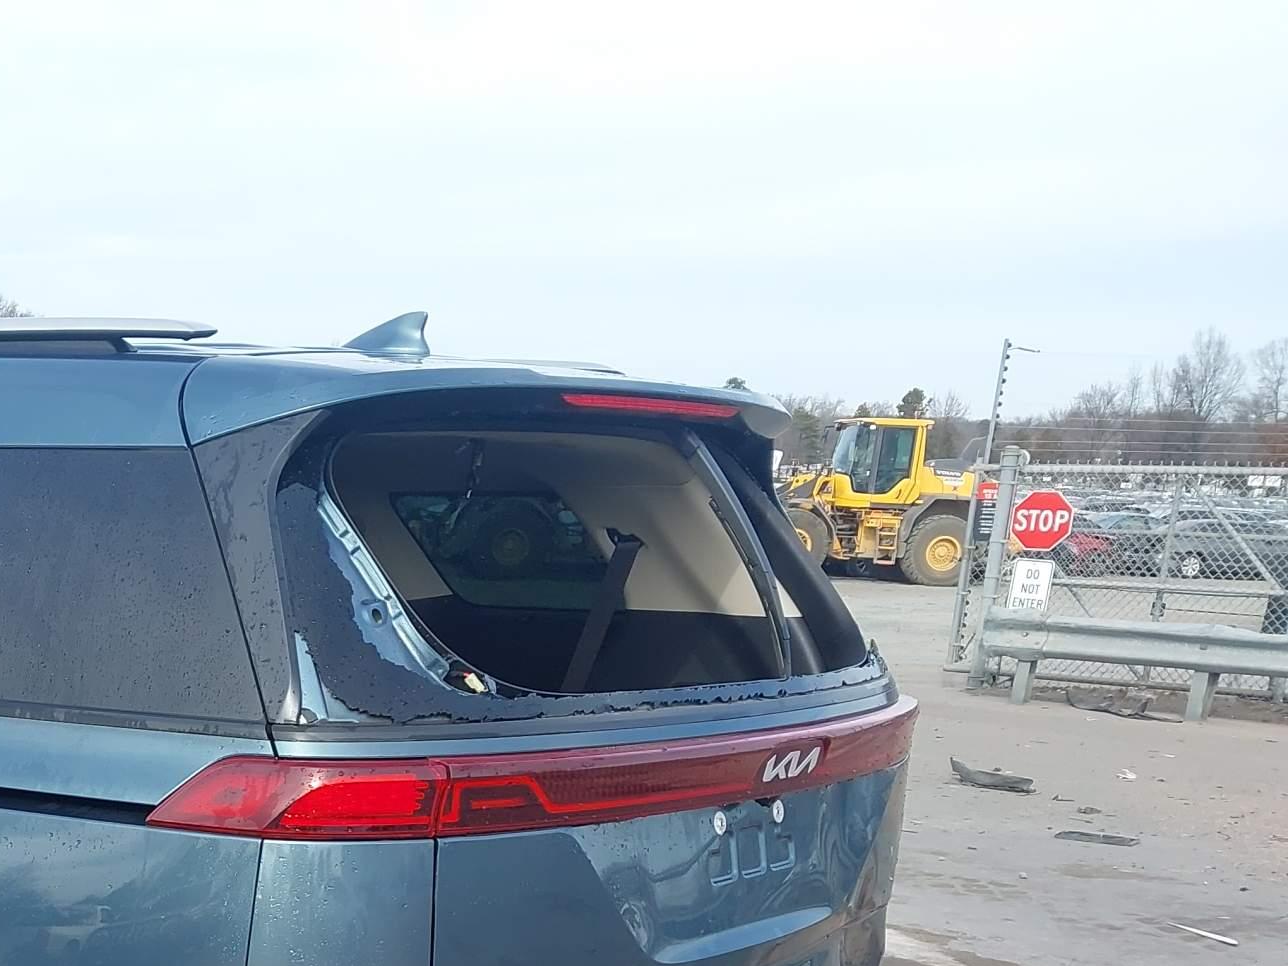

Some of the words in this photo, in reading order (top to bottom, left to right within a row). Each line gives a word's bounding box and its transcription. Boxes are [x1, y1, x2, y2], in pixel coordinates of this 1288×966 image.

[1014, 509, 1070, 532] STOP
[1025, 568, 1040, 580] DO
[1020, 583, 1041, 595] NOT
[1012, 596, 1044, 609] ENTER
[762, 746, 821, 782] KIA
